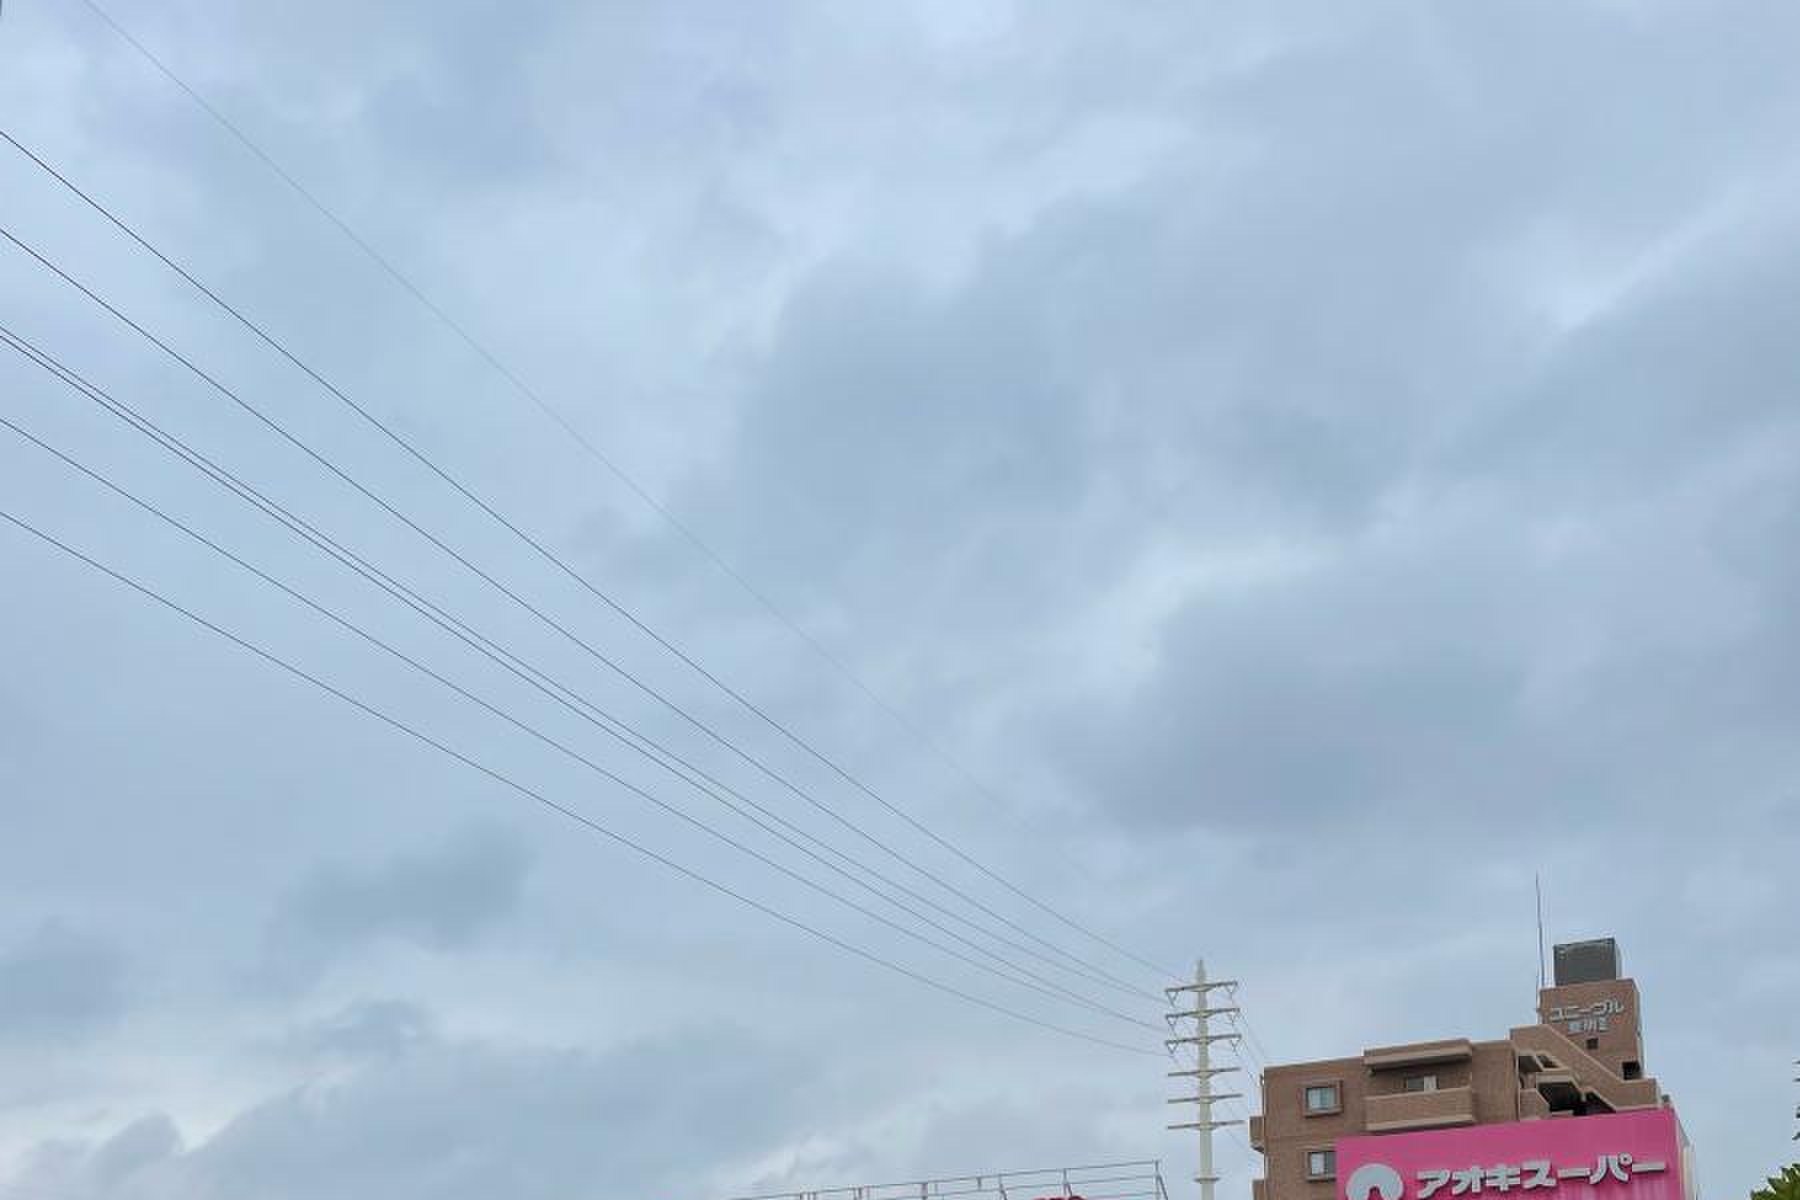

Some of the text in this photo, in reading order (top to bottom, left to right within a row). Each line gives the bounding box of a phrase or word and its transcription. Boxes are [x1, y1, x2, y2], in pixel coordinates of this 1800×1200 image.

[1417, 1153, 1665, 1199] アオキスーパー
